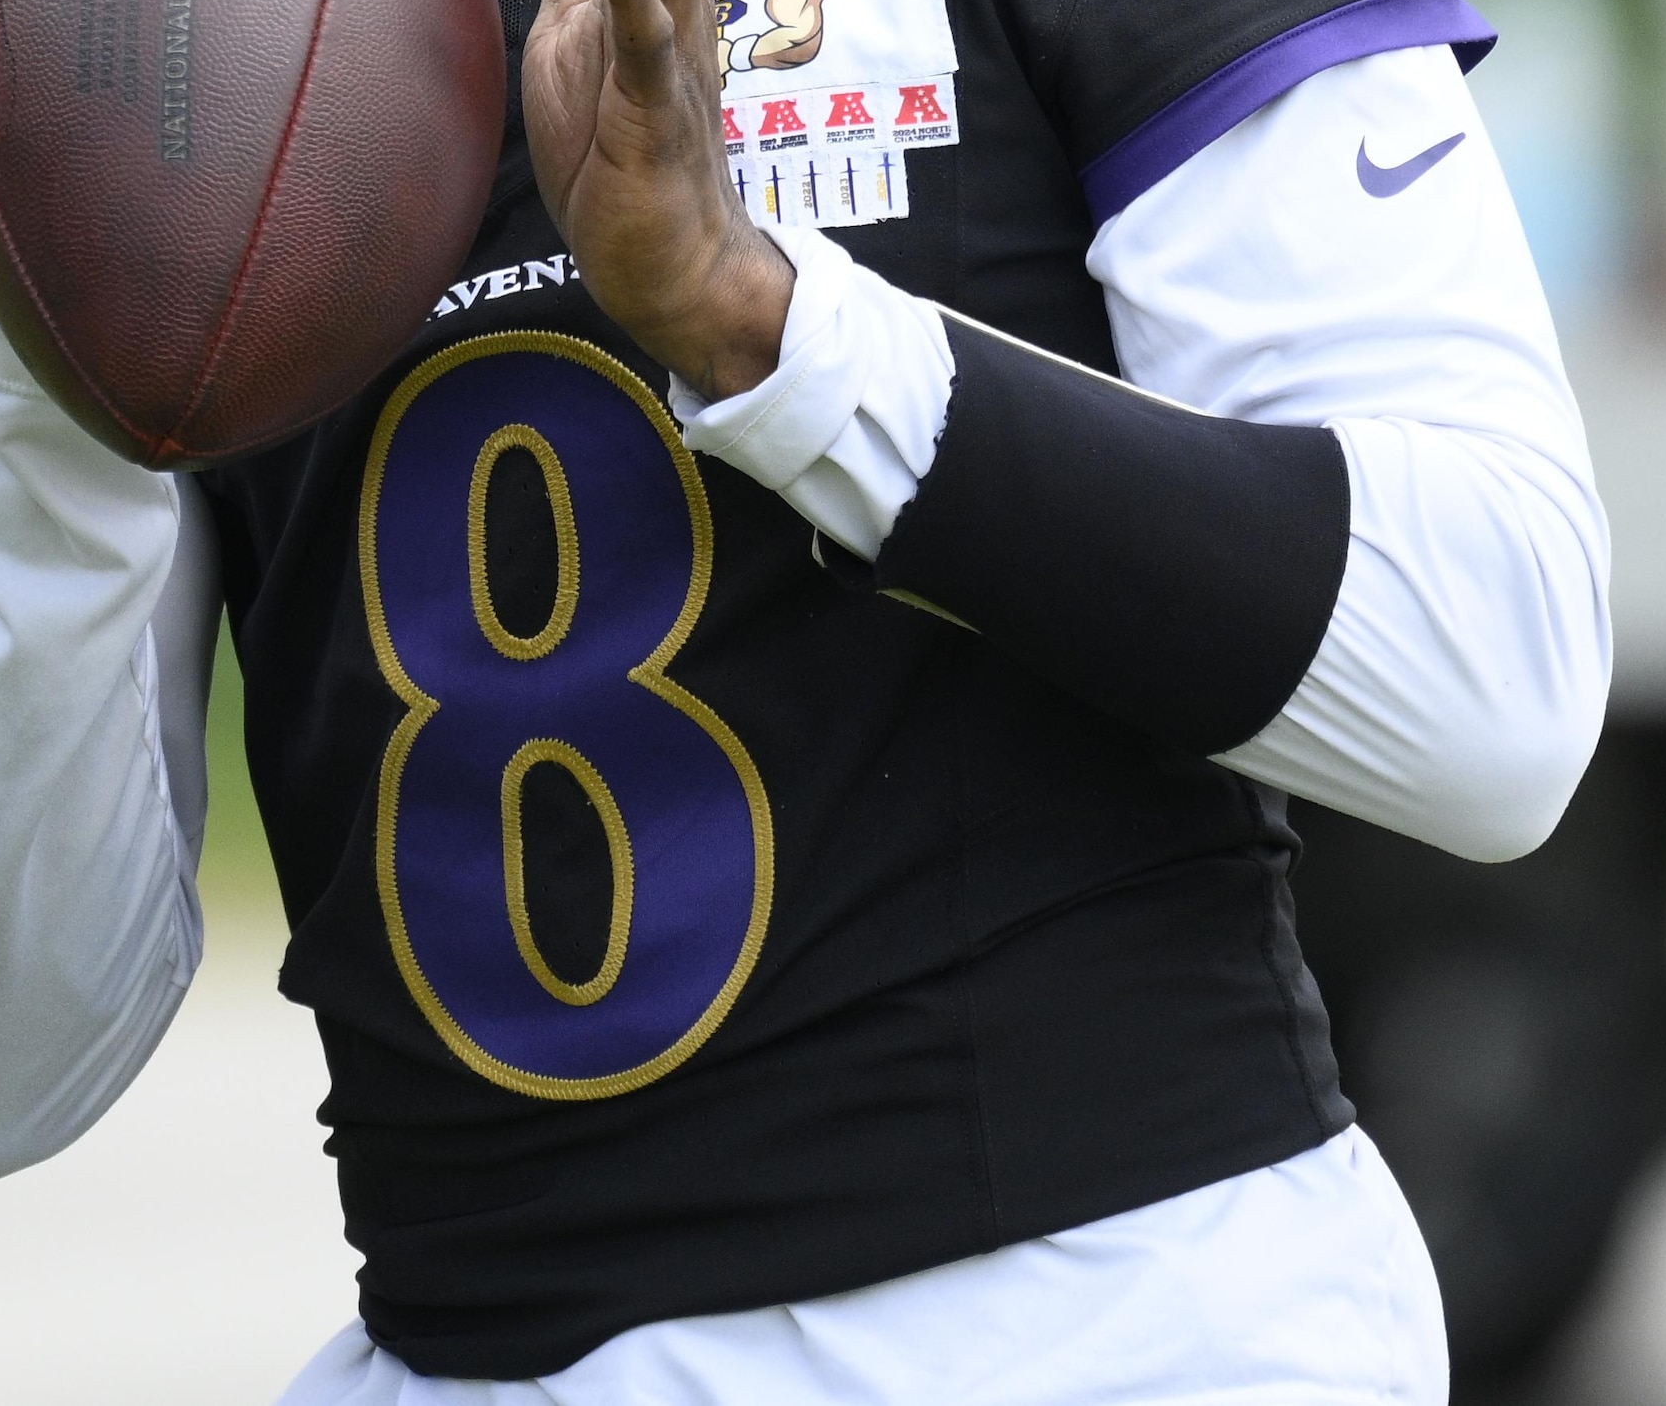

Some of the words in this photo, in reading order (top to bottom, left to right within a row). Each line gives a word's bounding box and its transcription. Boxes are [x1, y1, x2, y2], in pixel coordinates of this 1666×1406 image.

[758, 98, 806, 136] A
[825, 92, 874, 127] A
[894, 84, 948, 126] A
[781, 134, 807, 143] NORTH
[848, 128, 875, 136] NORTH
[892, 128, 916, 137] 2024
[918, 125, 951, 134] NORTH
[760, 141, 808, 152] CHAMPIONS
[765, 186, 776, 214] 2020
[802, 181, 813, 209] 2022
[841, 178, 851, 206] 2023
[878, 172, 887, 201] 2024
[428, 254, 581, 320] AVEN
[358, 330, 775, 1101] 8
